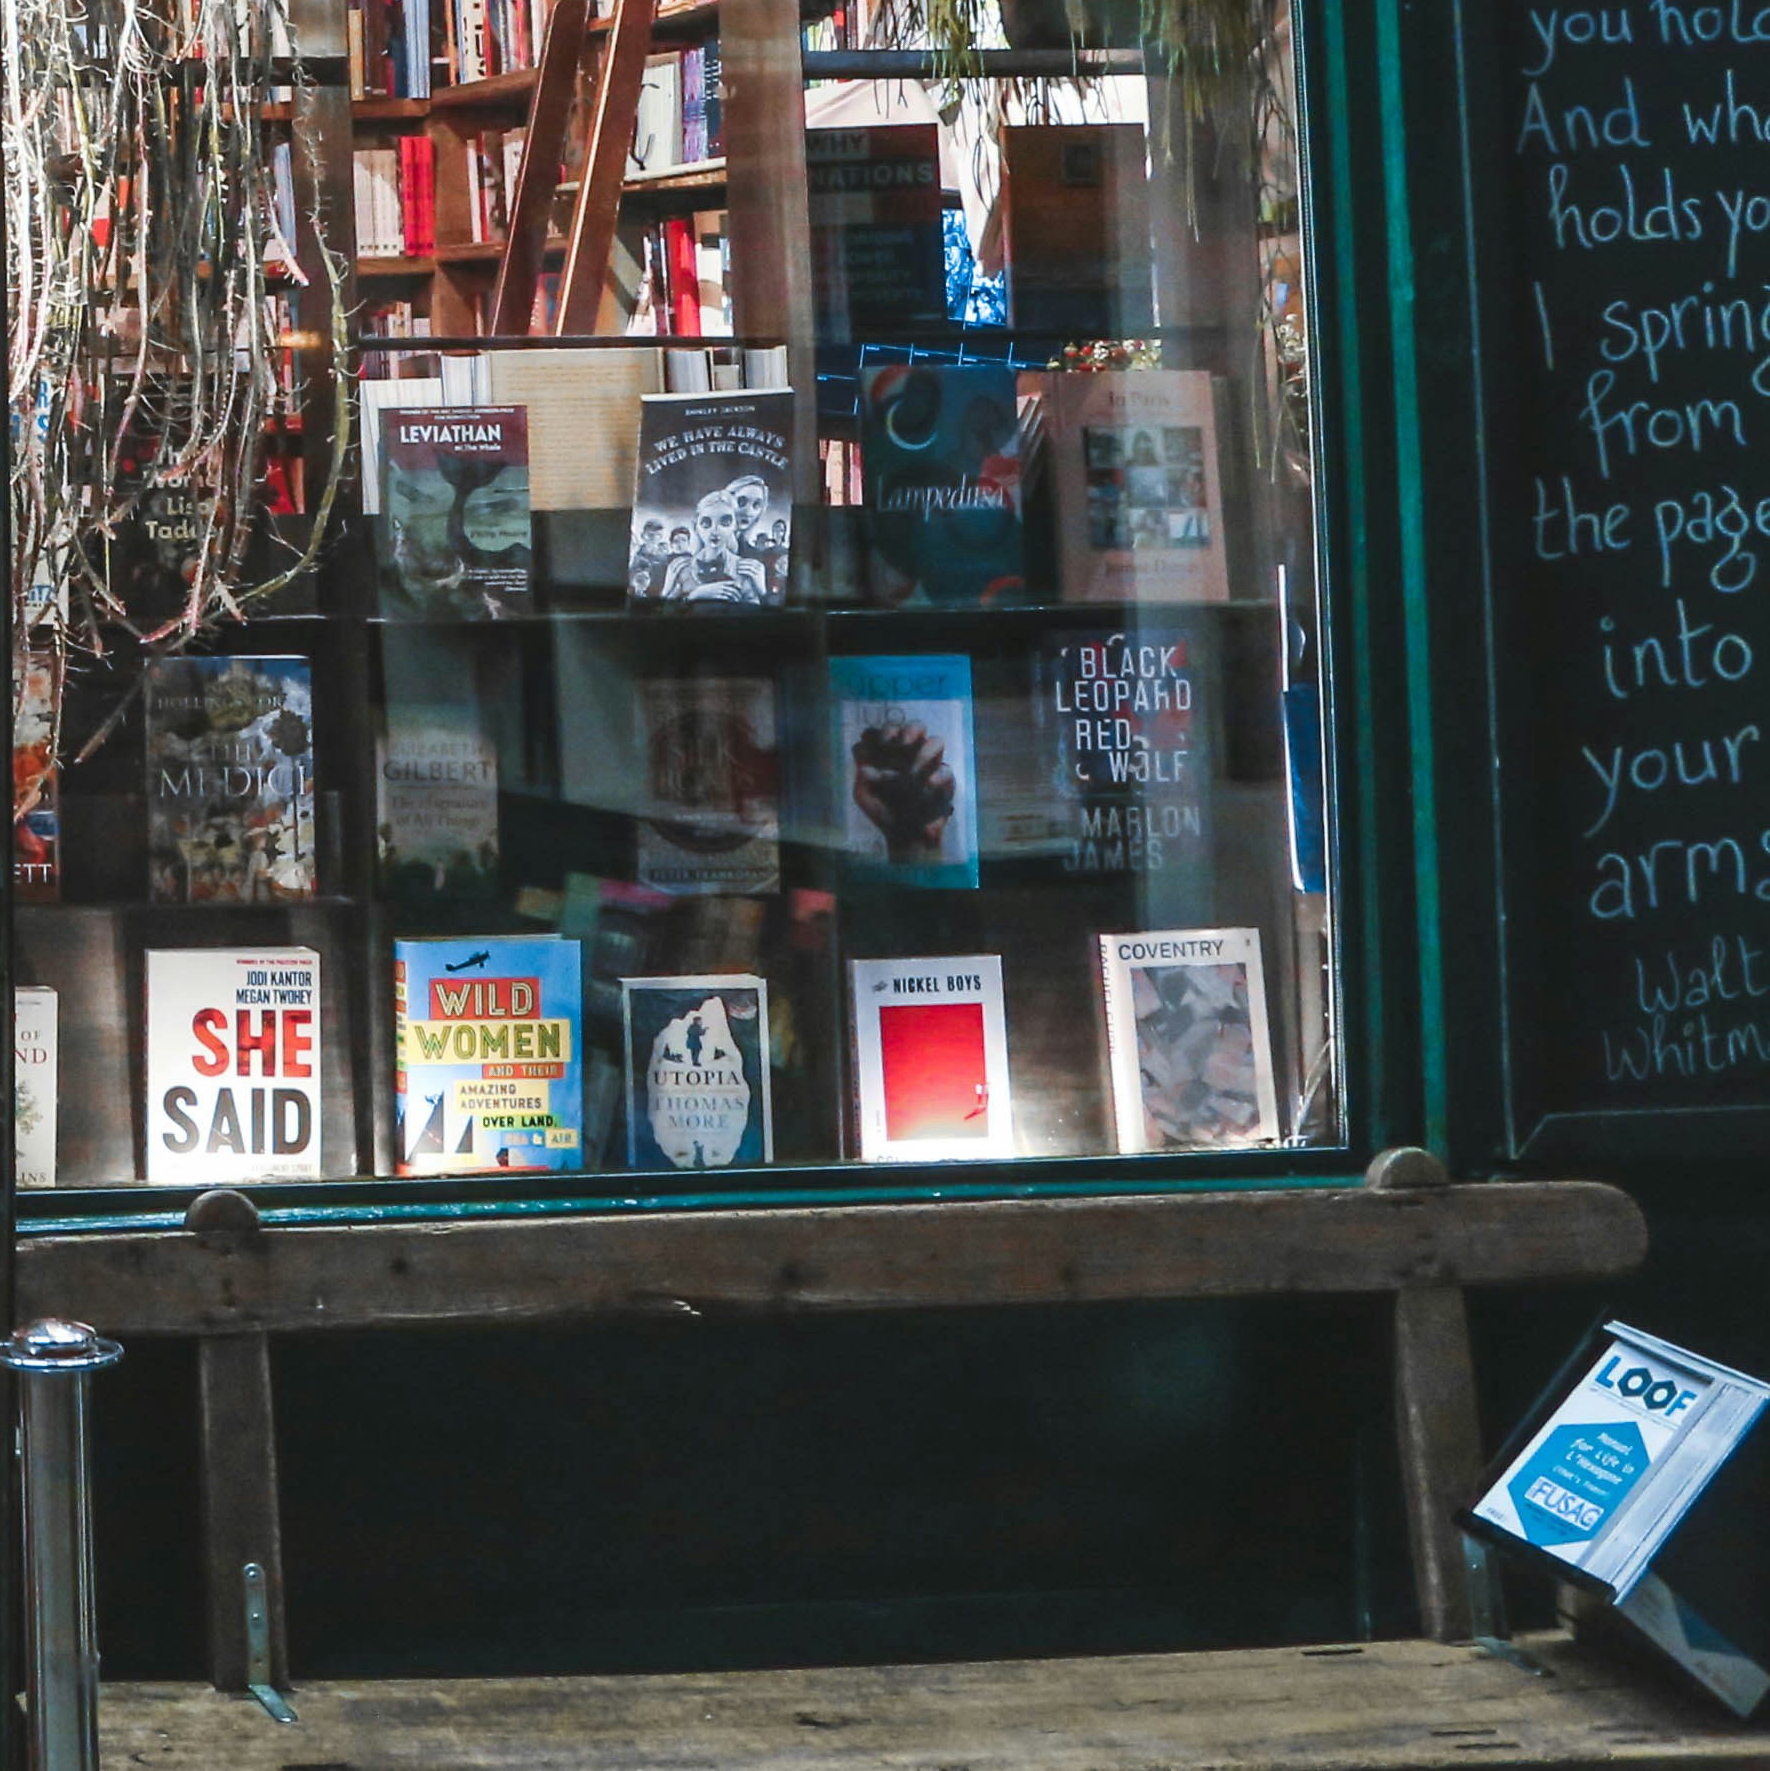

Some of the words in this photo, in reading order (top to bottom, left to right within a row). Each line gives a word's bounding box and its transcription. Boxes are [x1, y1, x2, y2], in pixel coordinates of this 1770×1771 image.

[1522, 9, 1634, 77] you
[1516, 77, 1652, 155] And
[1682, 68, 1770, 144] wh
[1549, 163, 1703, 249] holds
[1600, 281, 1770, 397] sprin
[399, 424, 502, 444] LEVIATHAN
[654, 435, 679, 453] WE
[683, 425, 723, 443] HAVE
[727, 425, 786, 448] ALWAYS
[1579, 369, 1748, 480] from
[645, 447, 687, 475] LIVED
[690, 441, 705, 457] IN
[709, 440, 735, 453] THE
[738, 441, 789, 470] CASTLE
[877, 473, 1008, 512] Lampedusa
[1532, 476, 1632, 562] the
[1080, 646, 1178, 679] BLACK
[1600, 597, 1752, 699] into
[1055, 679, 1192, 712] LEOPARD
[1075, 718, 1132, 750] RED
[383, 759, 493, 781] GILBERT
[1108, 749, 1187, 782] WOLF
[1581, 724, 1760, 839] your
[1081, 807, 1201, 837] MARLON
[1063, 842, 1164, 872] JAMES
[1118, 939, 1224, 962] COVENTRY
[246, 971, 268, 987] JODI
[270, 971, 312, 987] KANTOR
[893, 975, 941, 994] NICKEL
[947, 974, 983, 992] BOYS
[1635, 935, 1770, 1015] Walt
[235, 989, 270, 1005] MEGAN
[273, 989, 312, 1005] TWOHEY
[435, 981, 534, 1017] WILD
[21, 1030, 41, 1041] OF
[192, 1007, 312, 1077] SHE
[414, 1023, 561, 1060] WOMEN
[489, 1065, 514, 1078] AND
[653, 1070, 742, 1087] UTOPIA
[460, 1084, 517, 1096] AMAZING
[460, 1098, 543, 1111] ADVENTURES
[655, 1095, 746, 1112] THOMAS
[162, 1085, 312, 1156] SAID
[482, 1116, 515, 1128] OVER
[668, 1114, 730, 1129] MORE
[1594, 1354, 1698, 1418] LOOF
